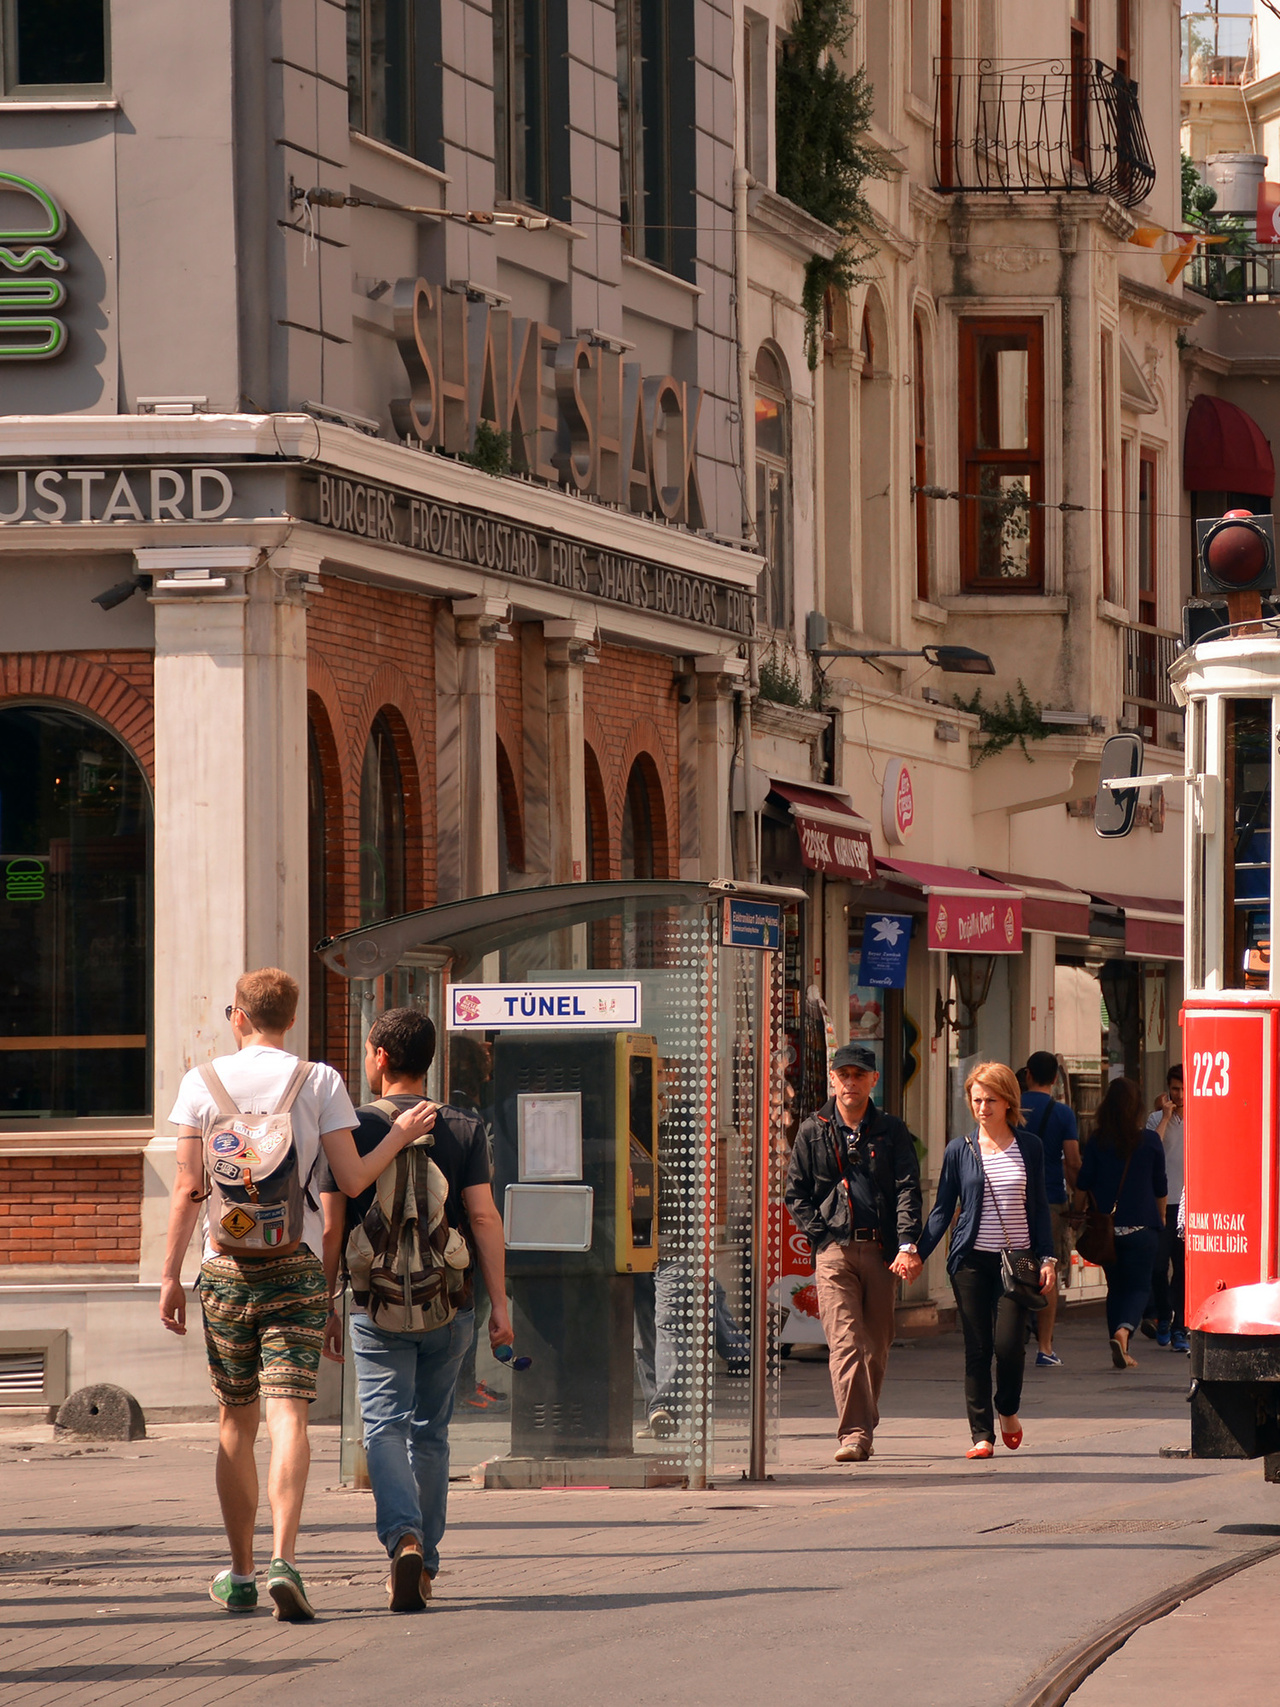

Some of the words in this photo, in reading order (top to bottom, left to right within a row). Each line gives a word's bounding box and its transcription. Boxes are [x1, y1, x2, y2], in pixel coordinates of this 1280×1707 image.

[393, 276, 560, 482] SHAKE
[556, 338, 708, 529] SHACK
[319, 474, 396, 542] BURGERS
[410, 500, 472, 560] FROZEN
[474, 519, 539, 578] CUSTARD
[550, 539, 588, 591] FRIES
[599, 552, 649, 608] SHAKES
[504, 992, 586, 1017] TÜNEL
[1193, 1051, 1230, 1097] 223
[1212, 1213, 1245, 1231] YASAK
[1192, 1232, 1248, 1253] TEHLİKELİDİR
